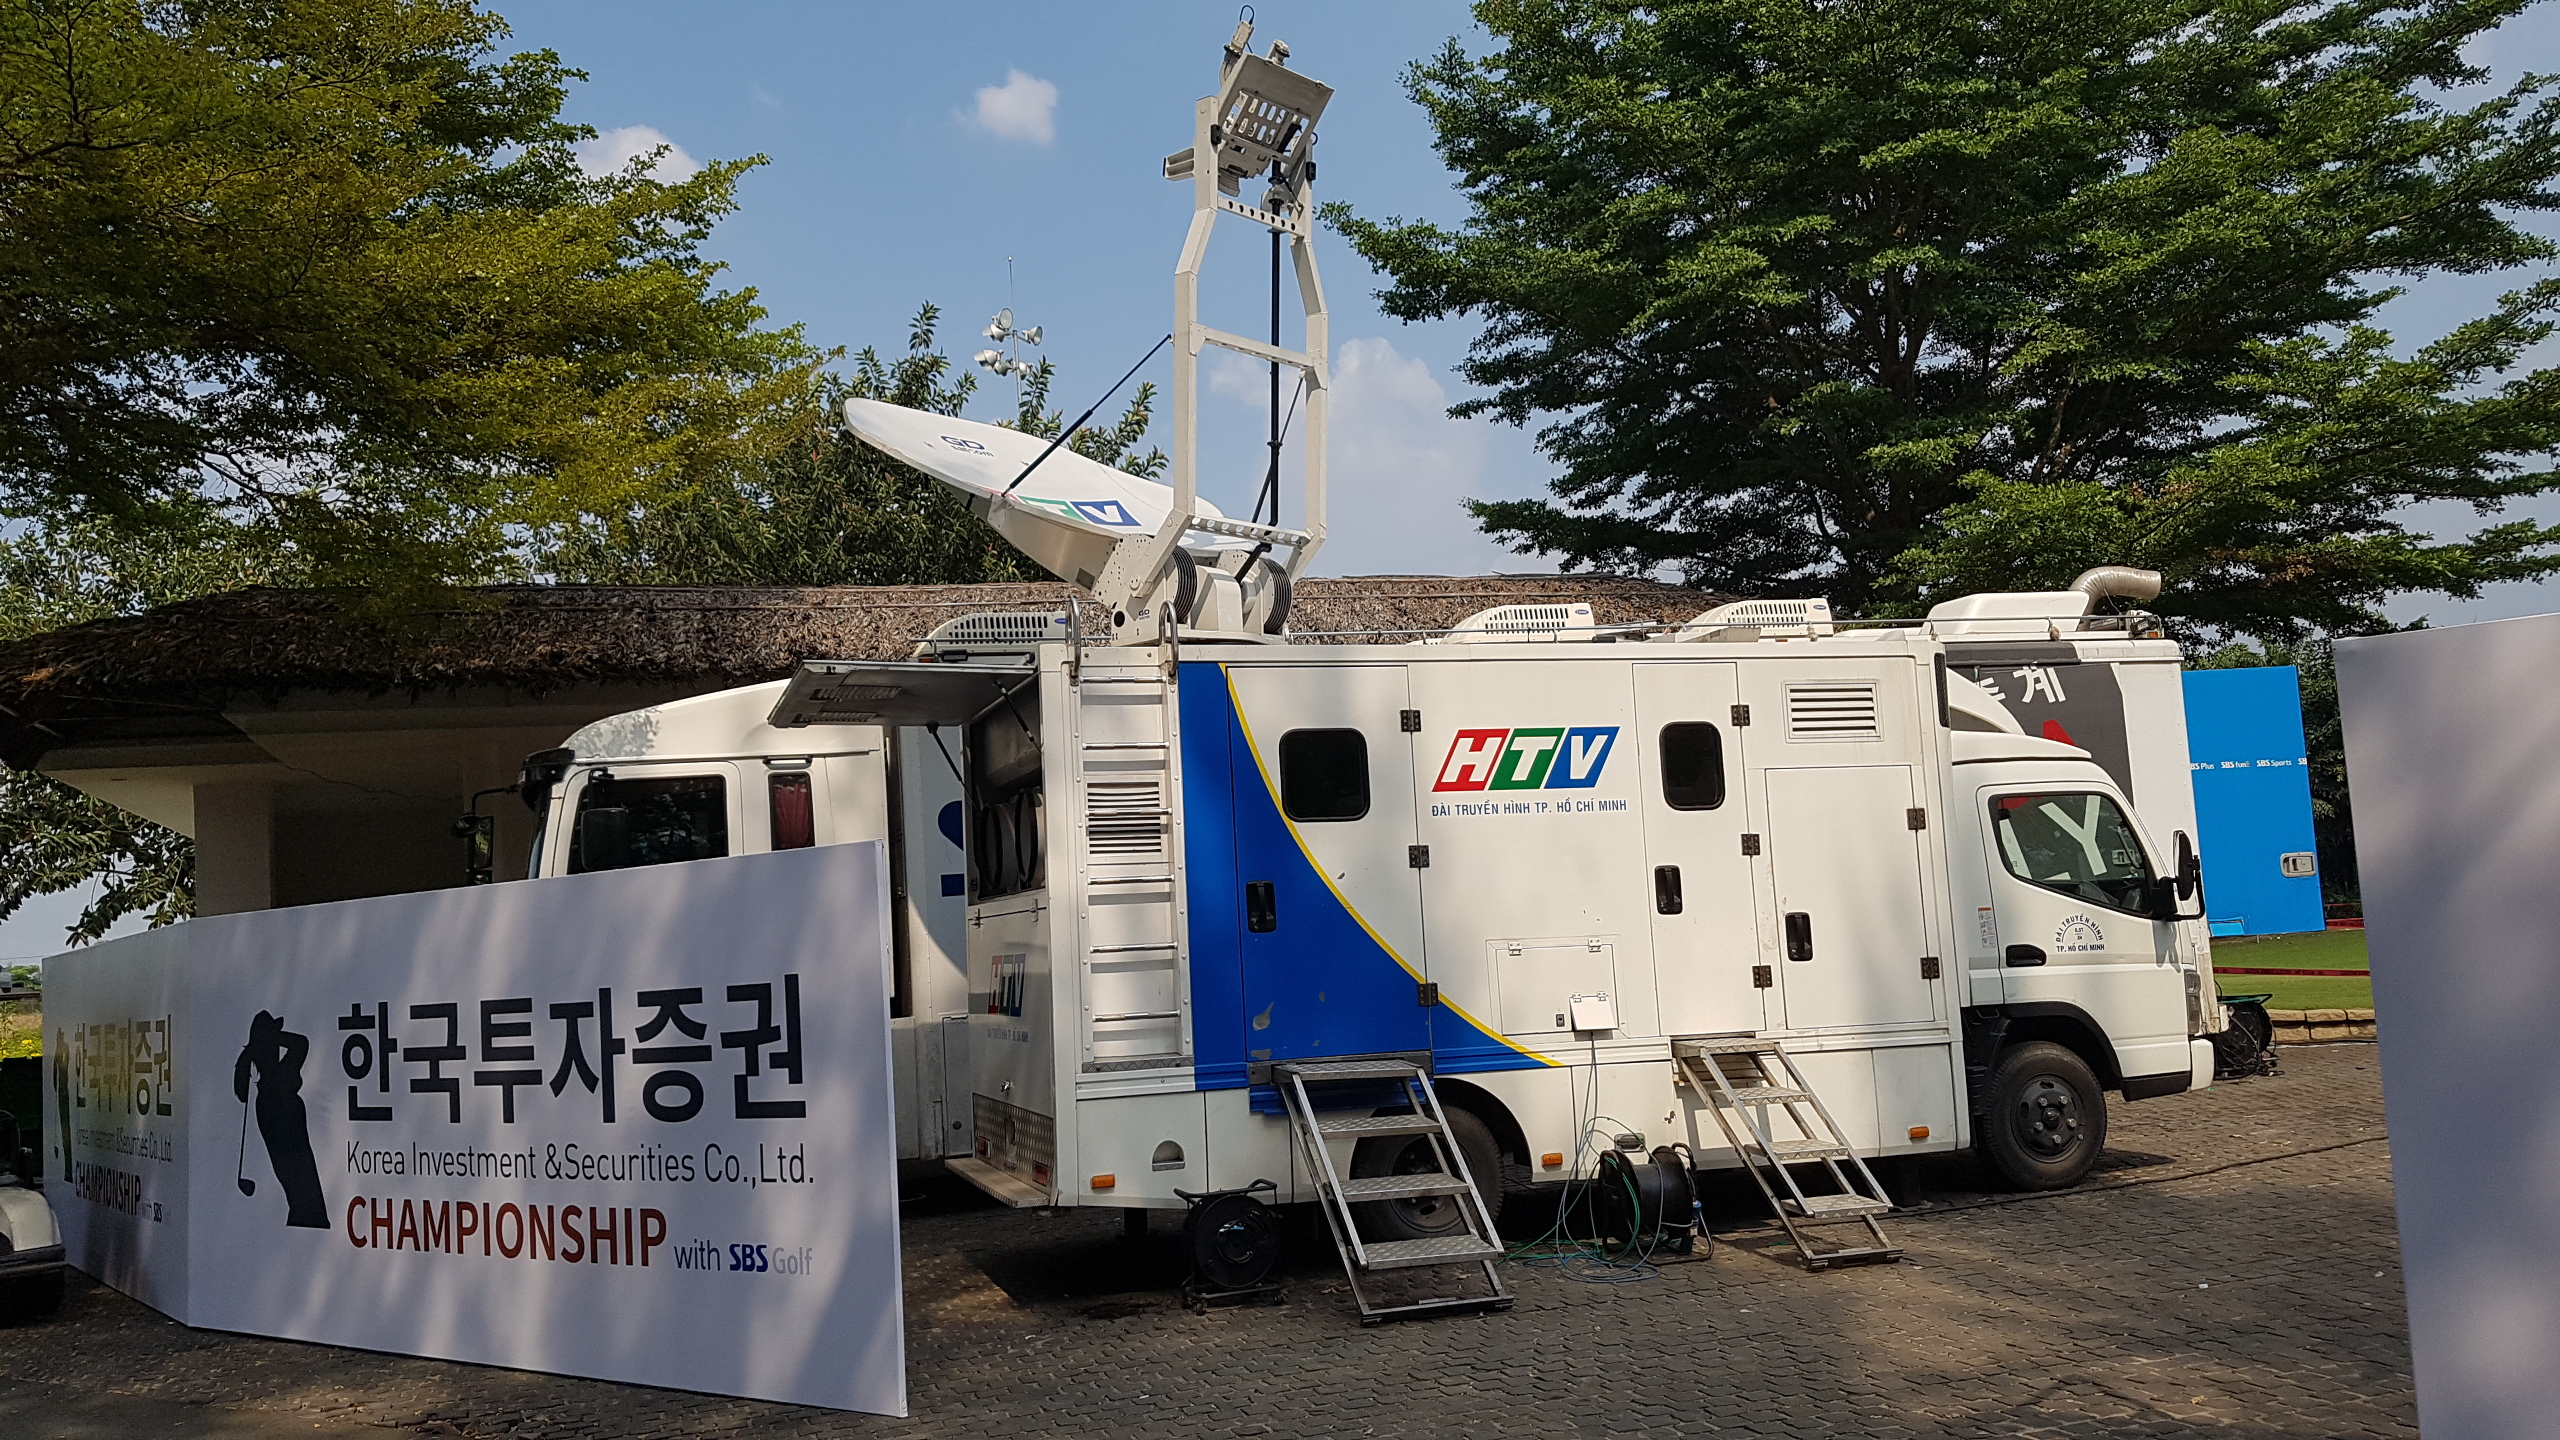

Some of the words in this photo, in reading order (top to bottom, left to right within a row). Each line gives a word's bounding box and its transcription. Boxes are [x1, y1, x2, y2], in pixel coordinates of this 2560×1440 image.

[1436, 730, 1615, 788] HTV
[2221, 761, 2235, 769] SBS
[2271, 760, 2292, 768] Sports
[1431, 802, 1451, 816] ĐÀI
[1455, 799, 1499, 815] TRUYỀN
[1503, 800, 1530, 814] HÌNH
[1534, 802, 1552, 813] TP.
[1557, 797, 1571, 813] HỒ
[1576, 798, 1594, 812] CHÍ
[1598, 799, 1627, 812] MINH
[988, 956, 1025, 1013] HTV
[75, 1014, 172, 1116] 한국투자증권
[338, 973, 807, 1124] 한국투자증권
[75, 1160, 142, 1217] CHAMPIONSHIP
[346, 1141, 405, 1176] Korea
[411, 1141, 537, 1179] Investment
[544, 1143, 696, 1184] &Securities
[703, 1143, 815, 1190] Co.,Ltd.
[346, 1195, 667, 1267] CHAMPIONSHIP
[673, 1239, 721, 1271] with
[729, 1243, 768, 1273] SBS
[772, 1247, 813, 1276] Golf
